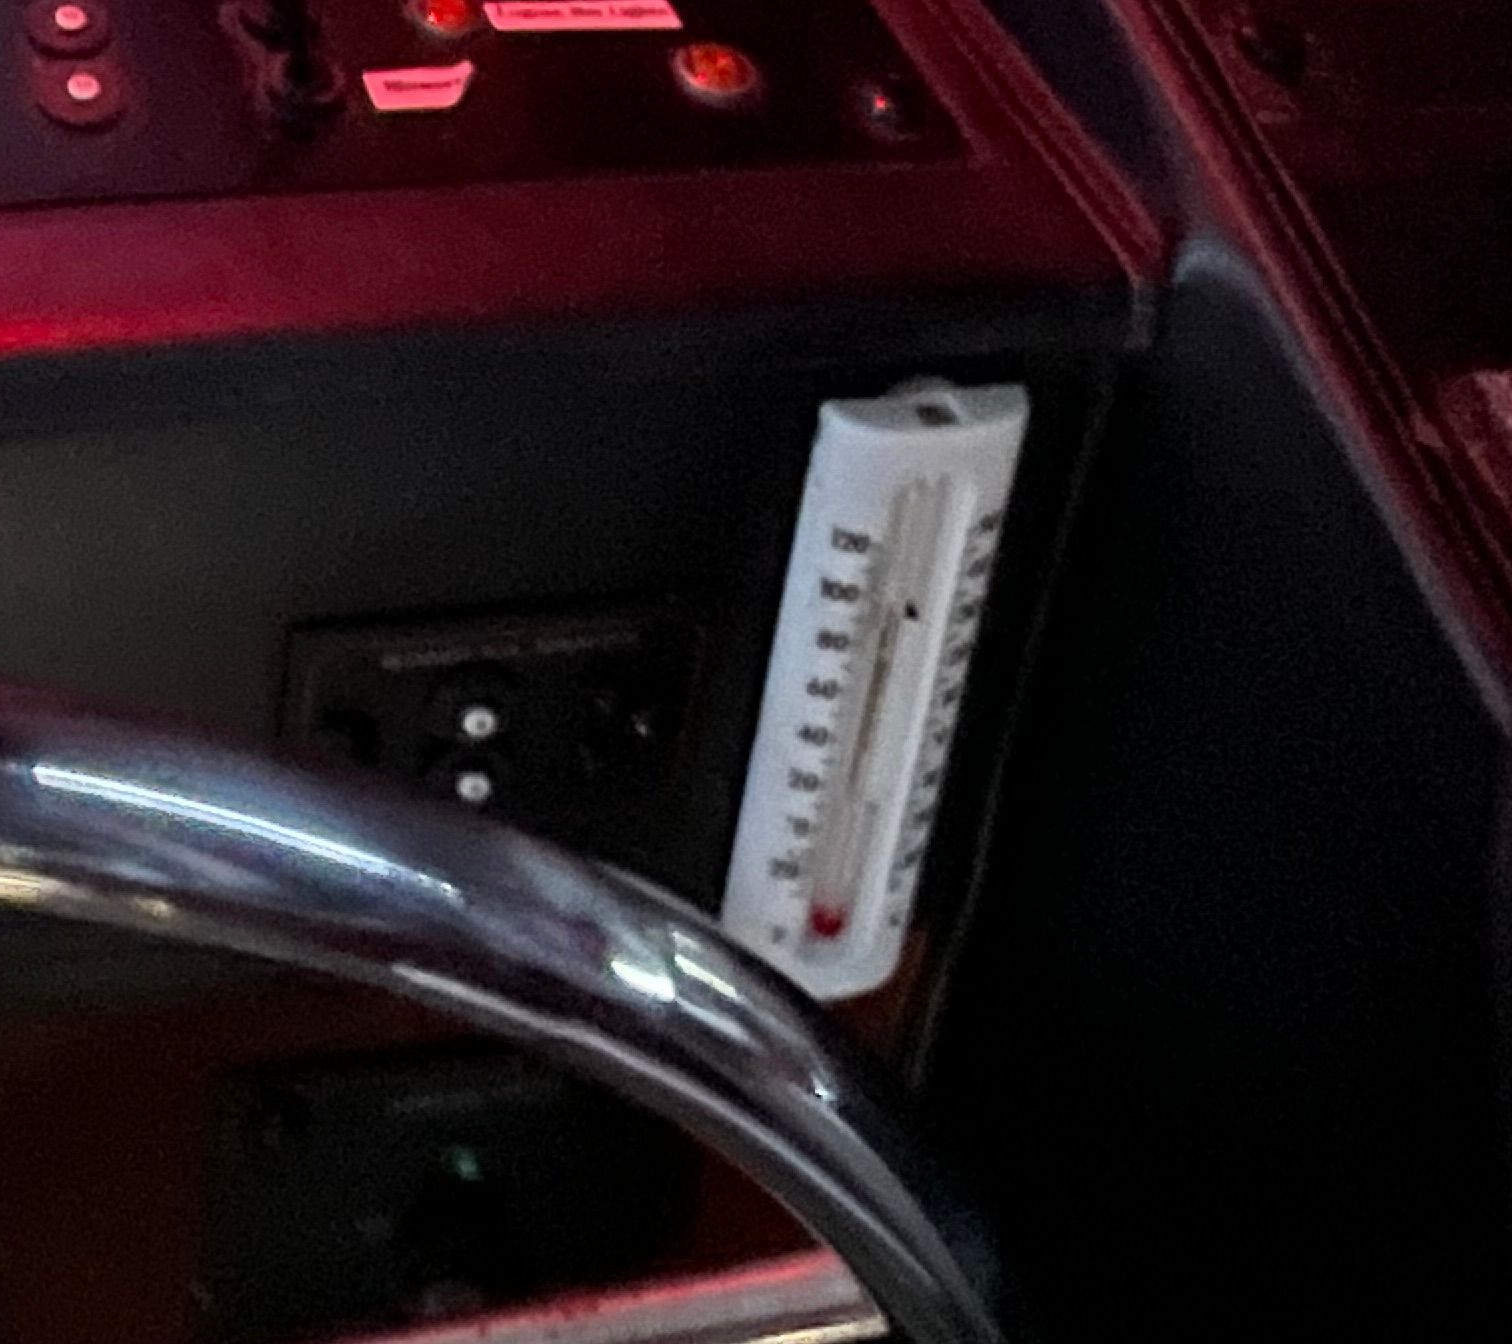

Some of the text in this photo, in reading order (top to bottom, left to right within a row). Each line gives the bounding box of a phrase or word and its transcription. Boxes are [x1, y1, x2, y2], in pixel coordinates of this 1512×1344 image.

[832, 524, 870, 555] 120
[817, 627, 850, 652] 80
[807, 677, 839, 700] 60
[798, 724, 829, 746] 40
[788, 769, 819, 792] 20
